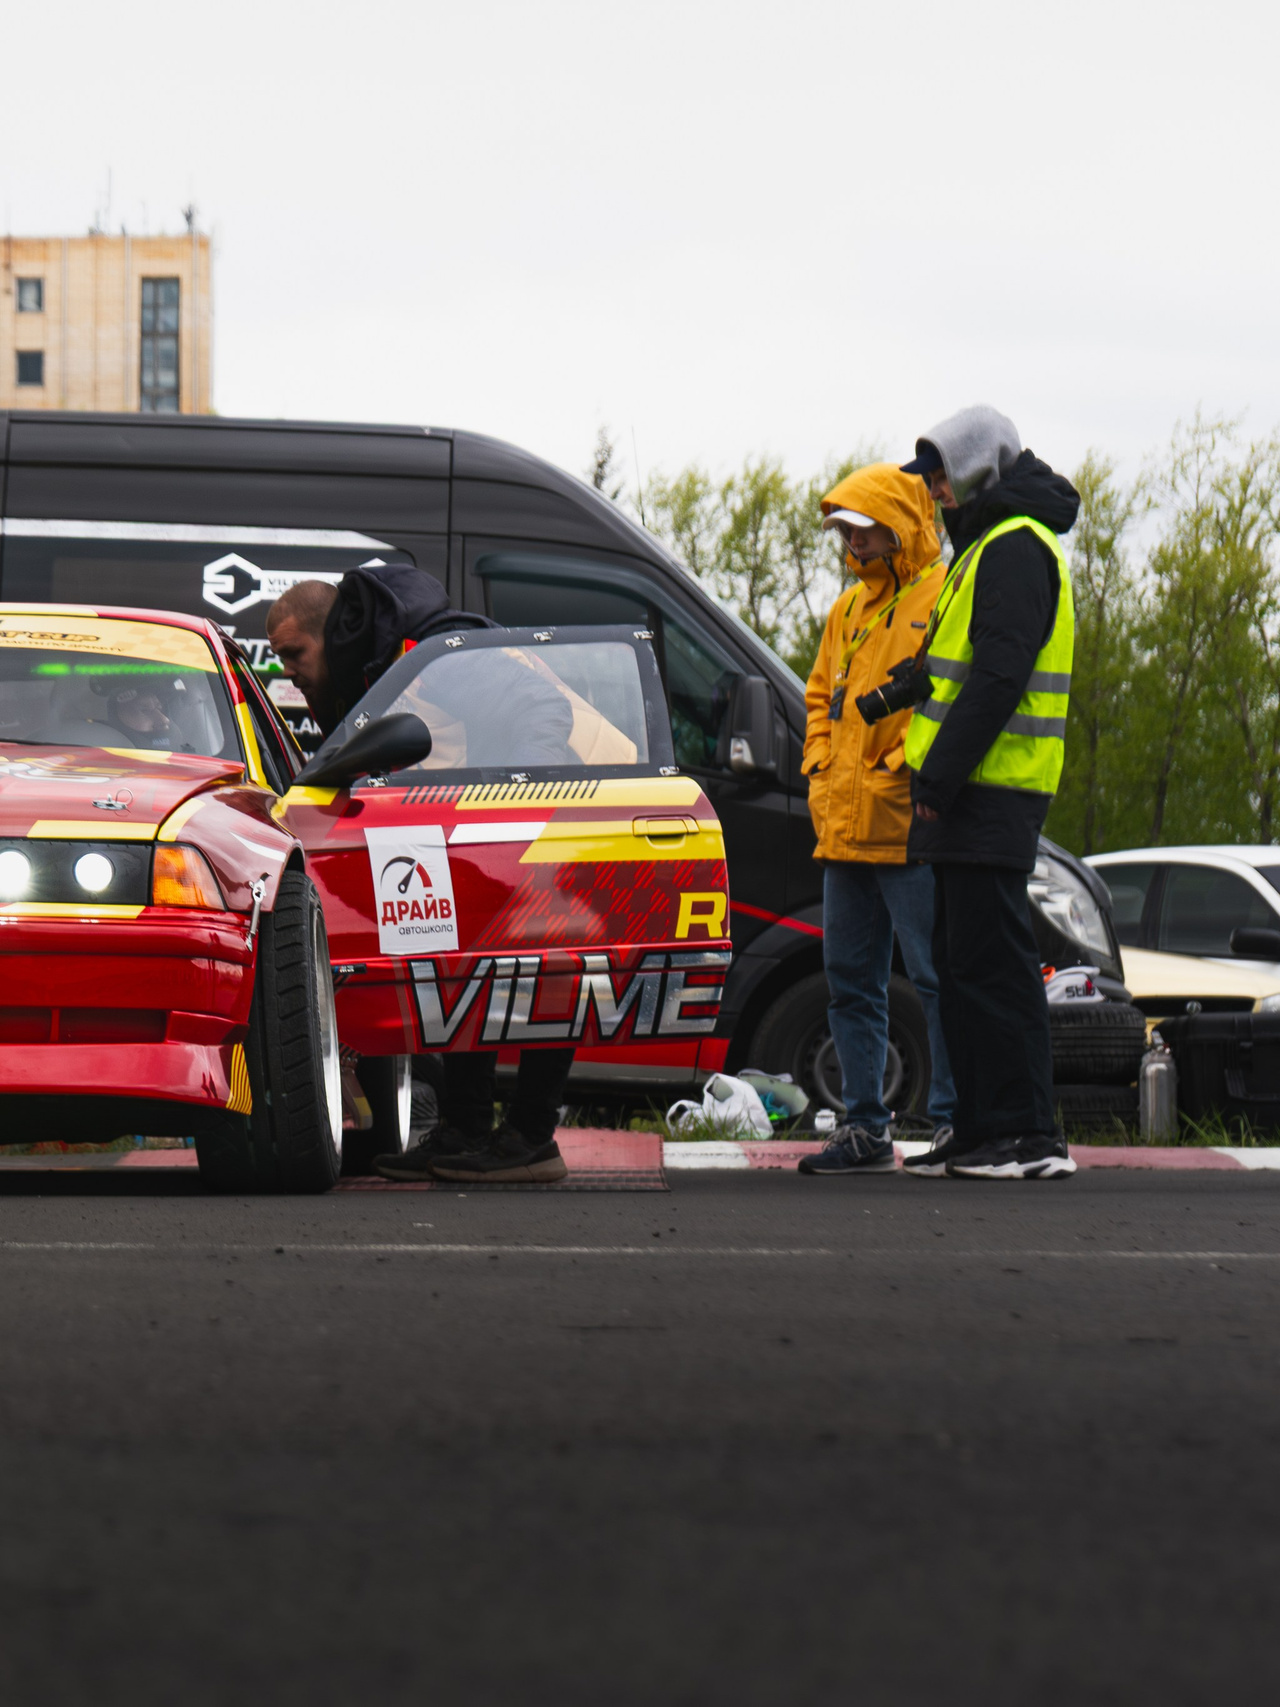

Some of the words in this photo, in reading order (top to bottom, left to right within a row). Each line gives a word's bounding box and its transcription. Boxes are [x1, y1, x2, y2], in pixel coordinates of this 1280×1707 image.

[381, 893, 453, 926] ДРАЙВ
[398, 924, 454, 935] автошкола
[410, 951, 731, 1045] VILME
